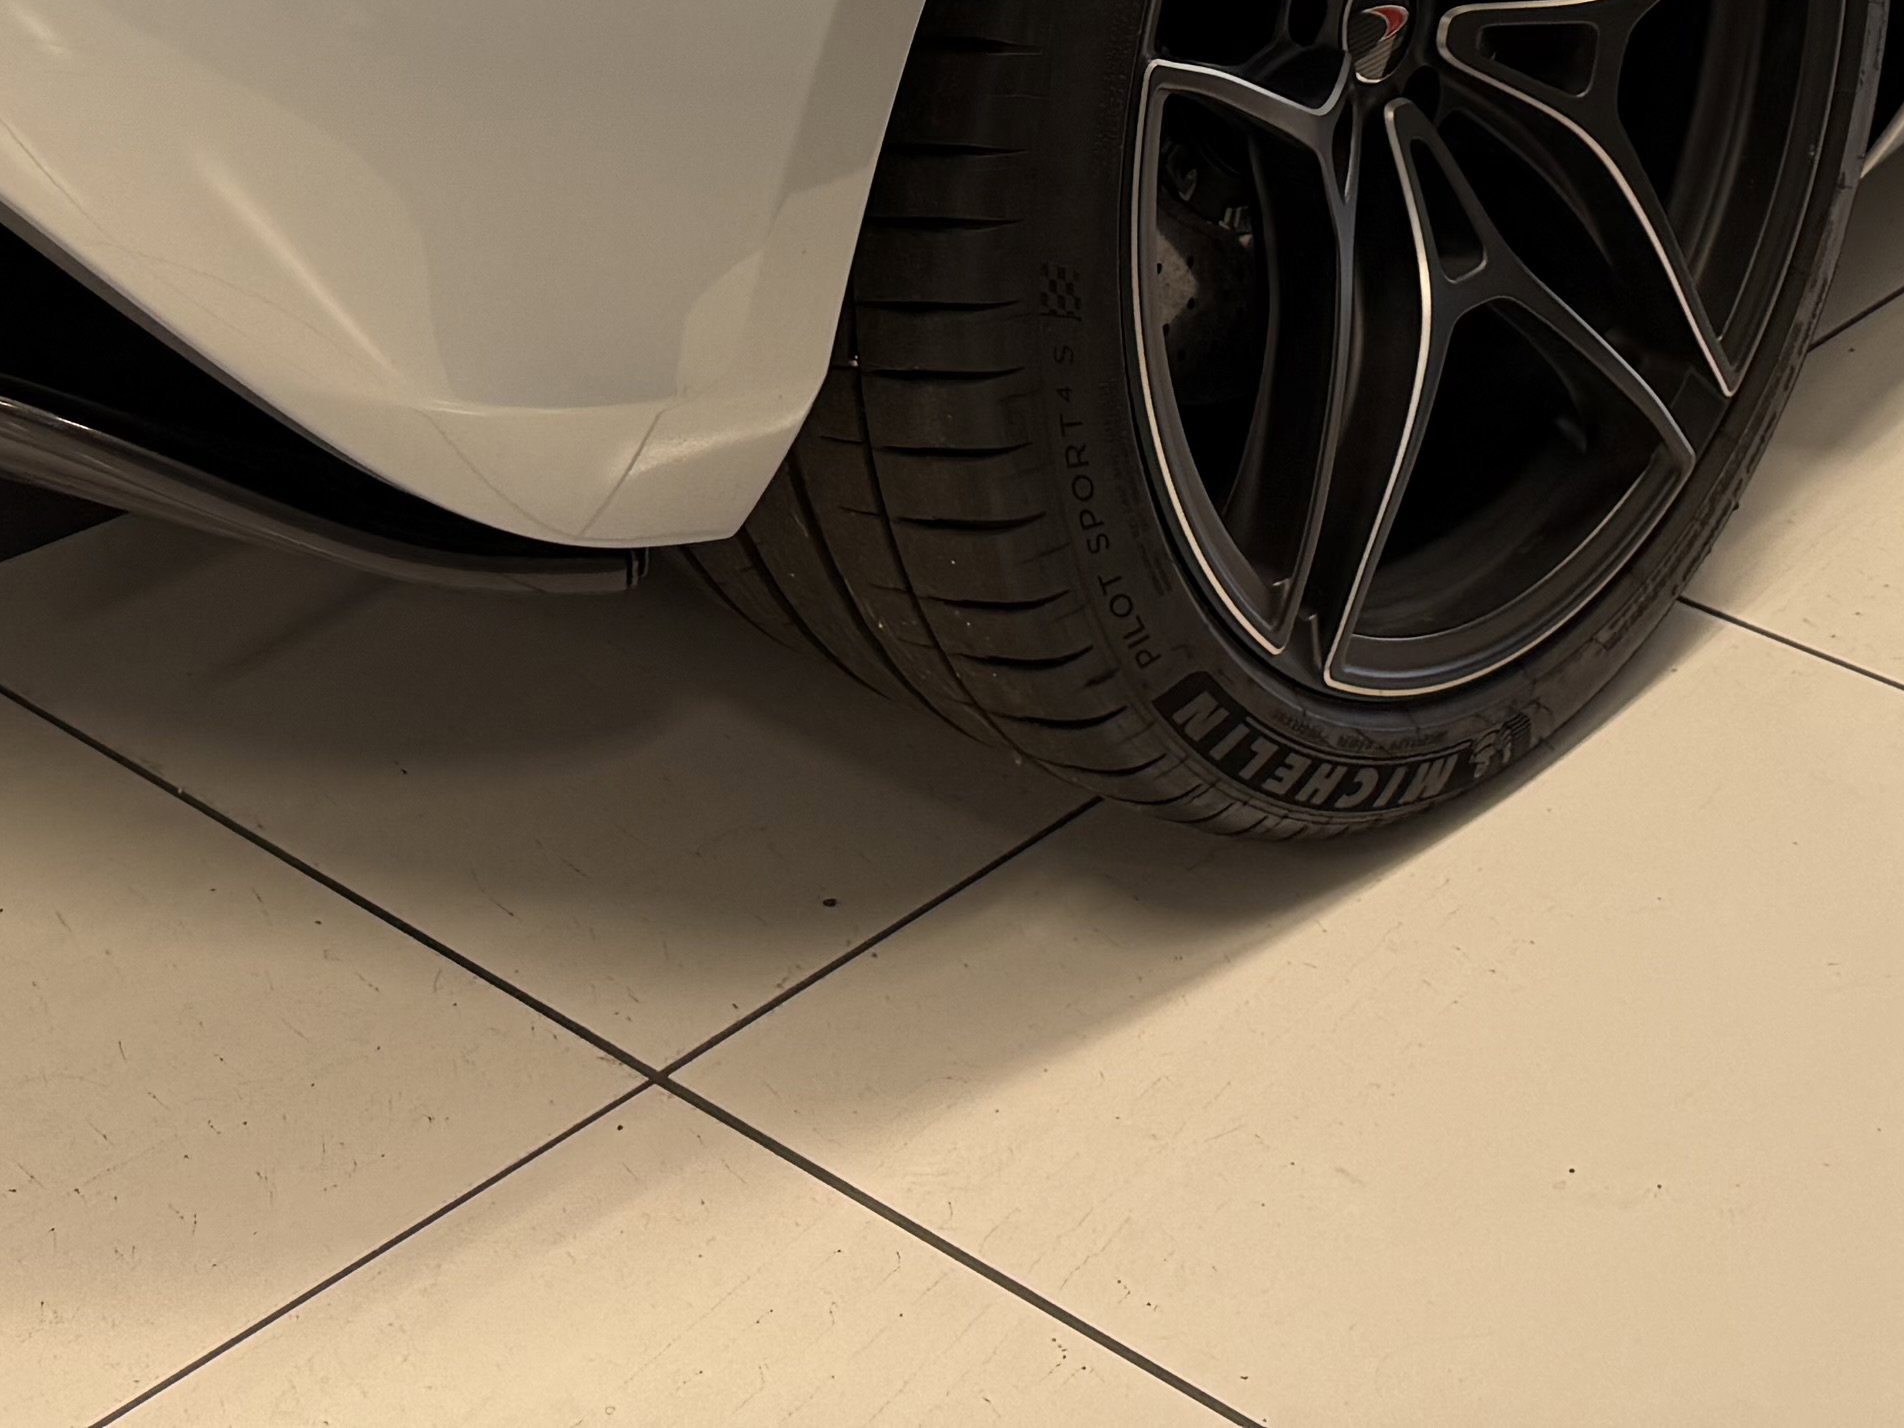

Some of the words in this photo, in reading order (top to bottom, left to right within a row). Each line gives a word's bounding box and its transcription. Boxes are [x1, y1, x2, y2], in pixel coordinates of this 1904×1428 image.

[1054, 346, 1074, 365] S
[1055, 386, 1074, 404] 4
[1060, 417, 1111, 555] SPORT
[1096, 575, 1162, 670] PILOT
[1172, 689, 1457, 810] MICHELIN
